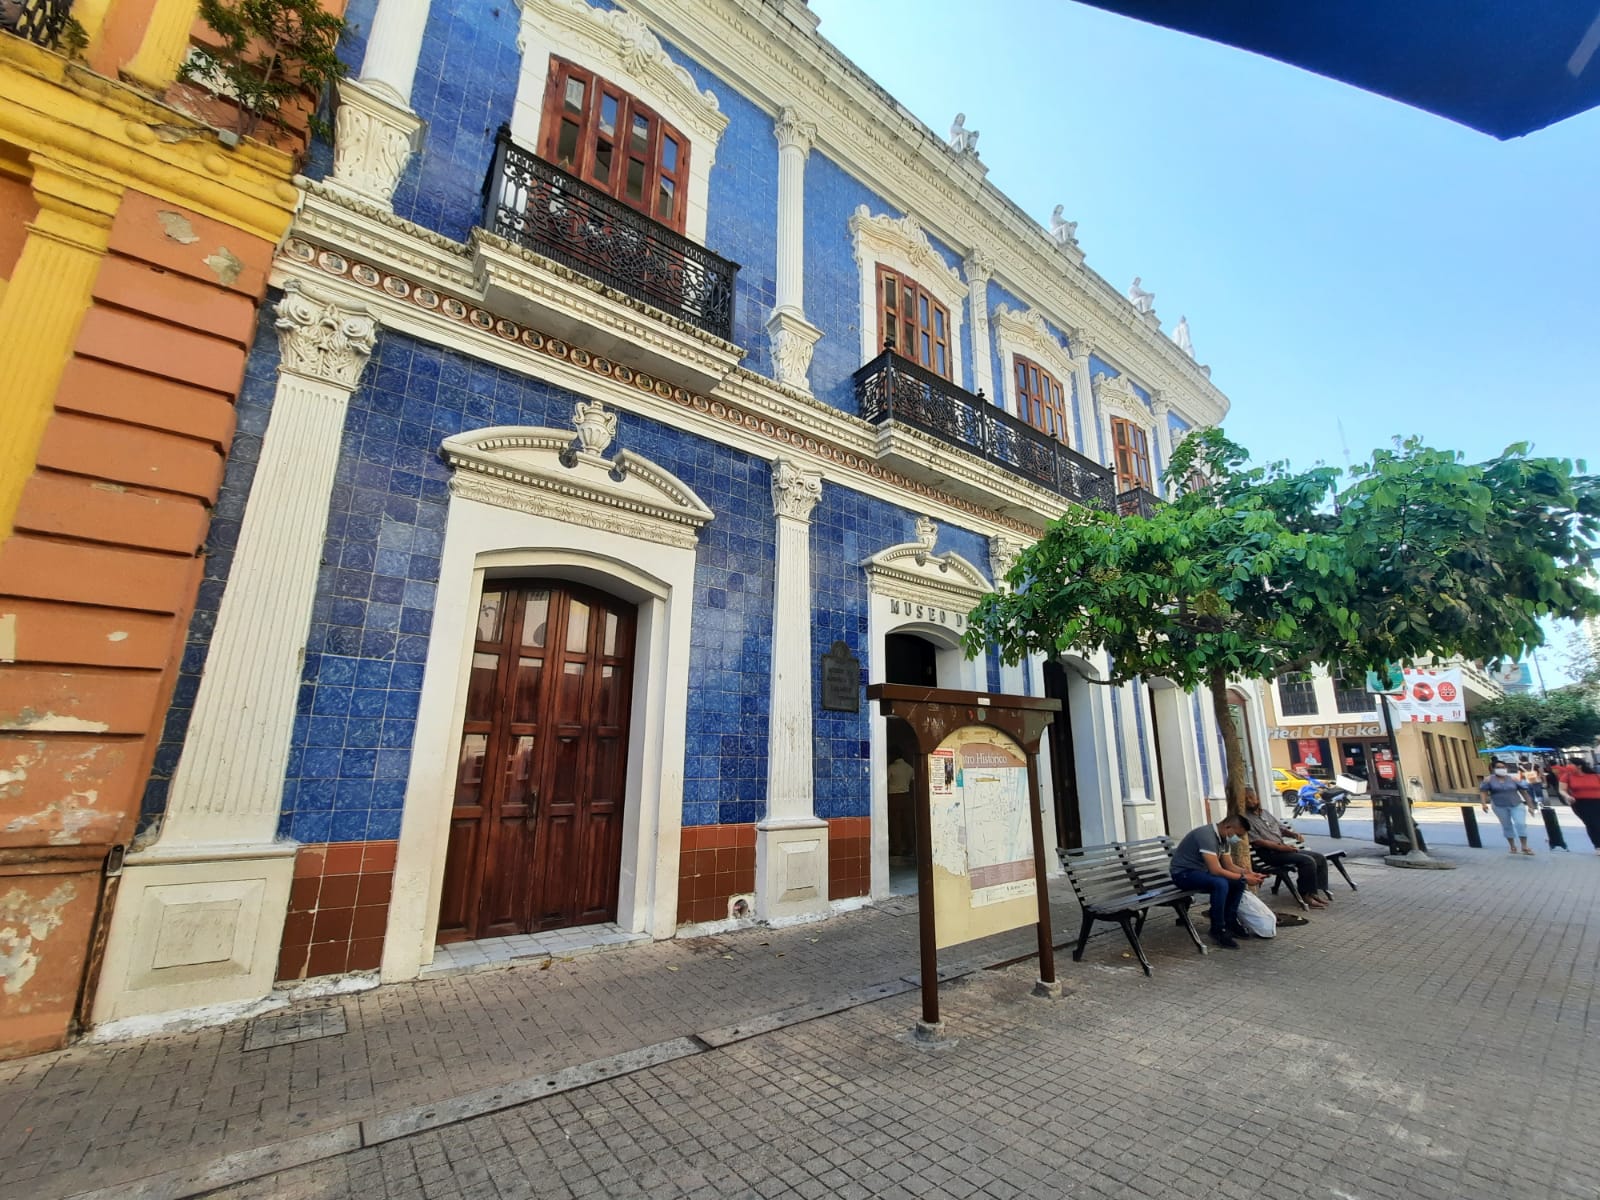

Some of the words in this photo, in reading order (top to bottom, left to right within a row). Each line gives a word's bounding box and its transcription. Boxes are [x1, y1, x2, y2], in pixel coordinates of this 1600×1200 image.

[890, 599, 946, 623] MUSEO
[1267, 726, 1303, 739] ried
[1308, 724, 1388, 738] Chicke
[964, 754, 975, 765] tro
